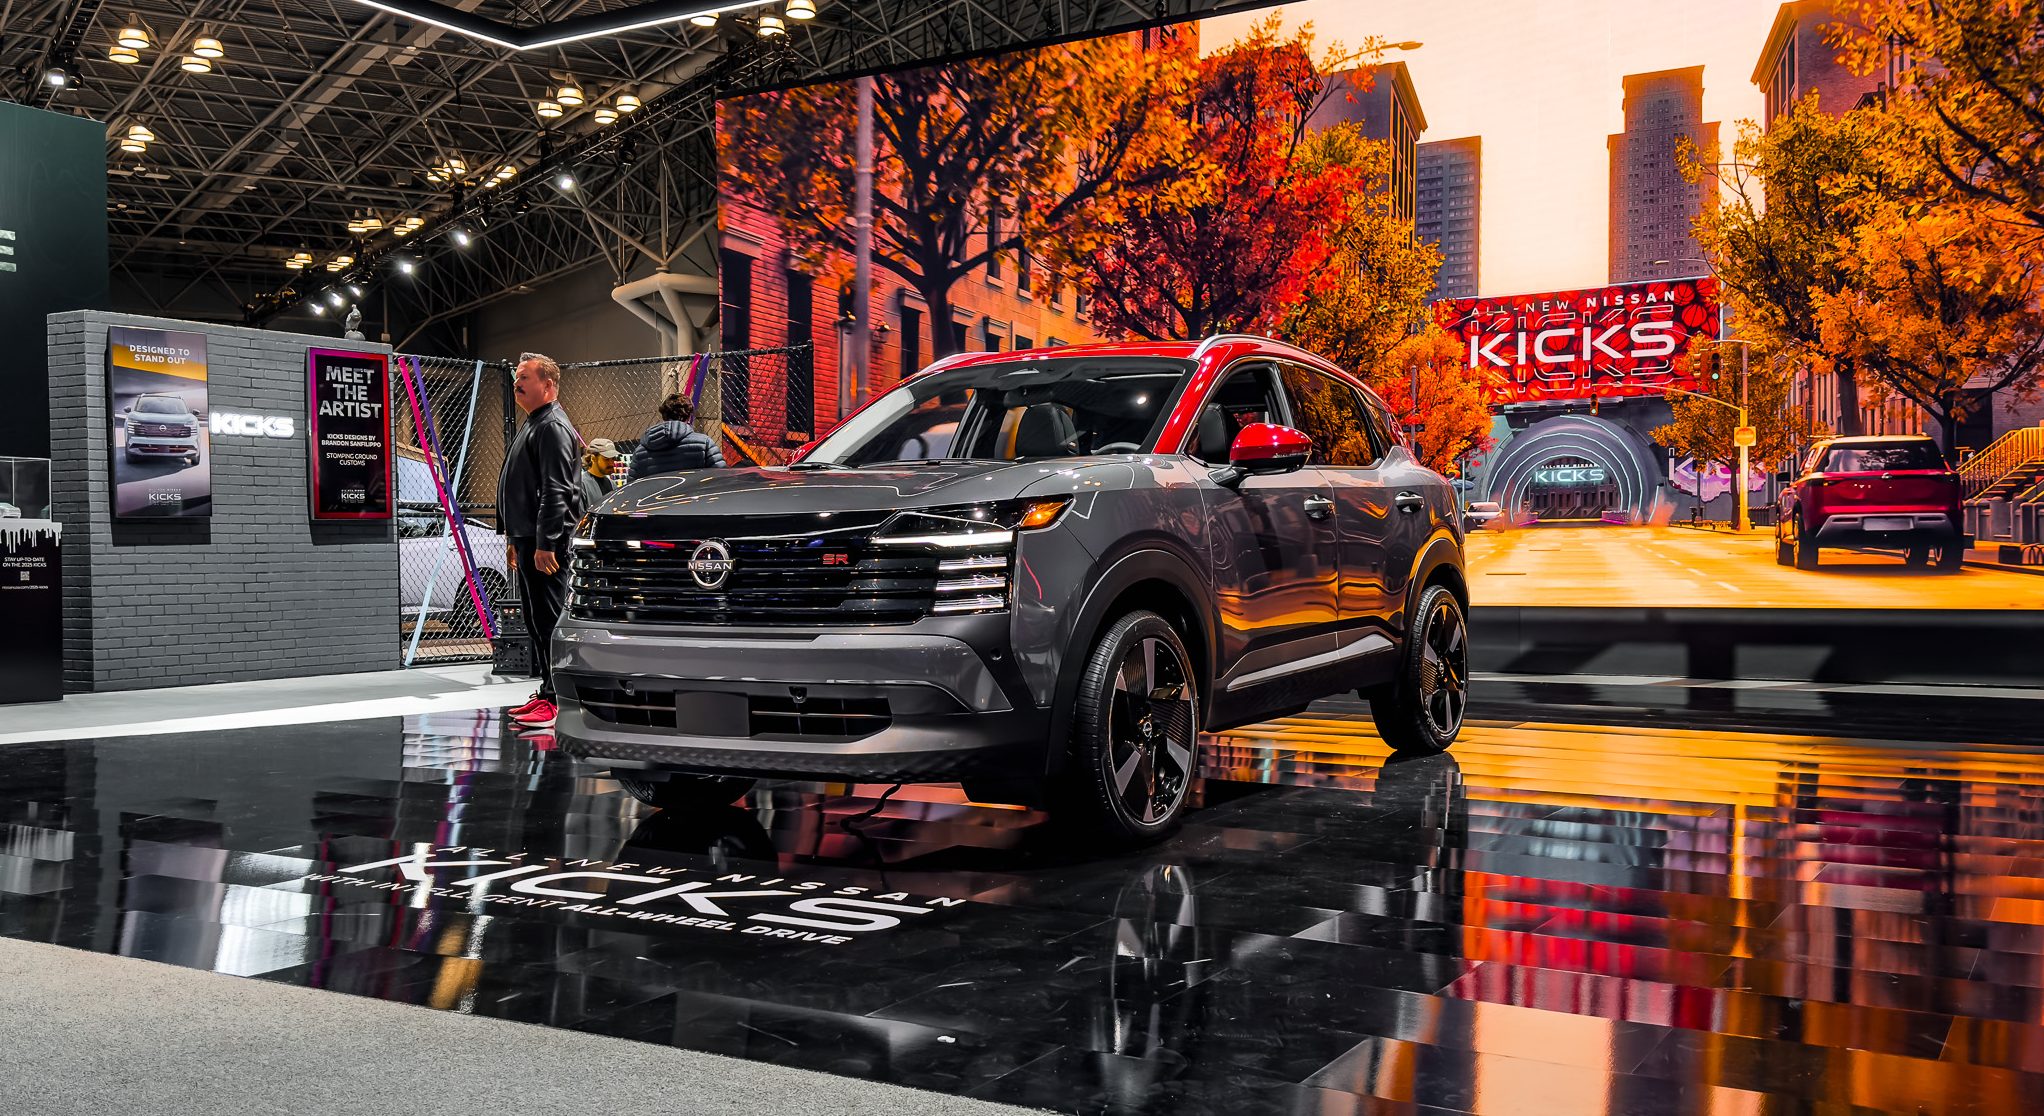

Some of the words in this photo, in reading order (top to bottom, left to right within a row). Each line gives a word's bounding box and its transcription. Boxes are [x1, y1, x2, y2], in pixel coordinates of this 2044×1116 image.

[1470, 300, 1570, 317] ALL-NEW
[1586, 290, 1676, 308] NISSAN
[129, 344, 176, 355] DESIGNED
[178, 348, 190, 356] TO
[1470, 320, 1676, 368] KICKS
[134, 353, 165, 363] STAND
[167, 356, 186, 365] OUT
[325, 365, 375, 385] MEET
[332, 383, 368, 401] THE
[319, 400, 382, 419] ARTIST
[209, 412, 295, 438] KICKS
[321, 439, 349, 447] BRANDON
[326, 452, 354, 460] STOMPING
[339, 459, 366, 467] CUSTOMS
[1535, 469, 1605, 482] KICKS
[148, 493, 182, 501] KICKS
[688, 562, 732, 570] NISSAN
[822, 553, 849, 565] SR
[436, 846, 688, 875] ALL-NEW
[716, 873, 967, 907] NISSAN
[336, 853, 935, 932] KICKS
[304, 873, 376, 887] WITH
[371, 882, 567, 908] INTELLGENT
[559, 903, 737, 931] ALL-WHEEL
[741, 925, 854, 945] DRIVE
